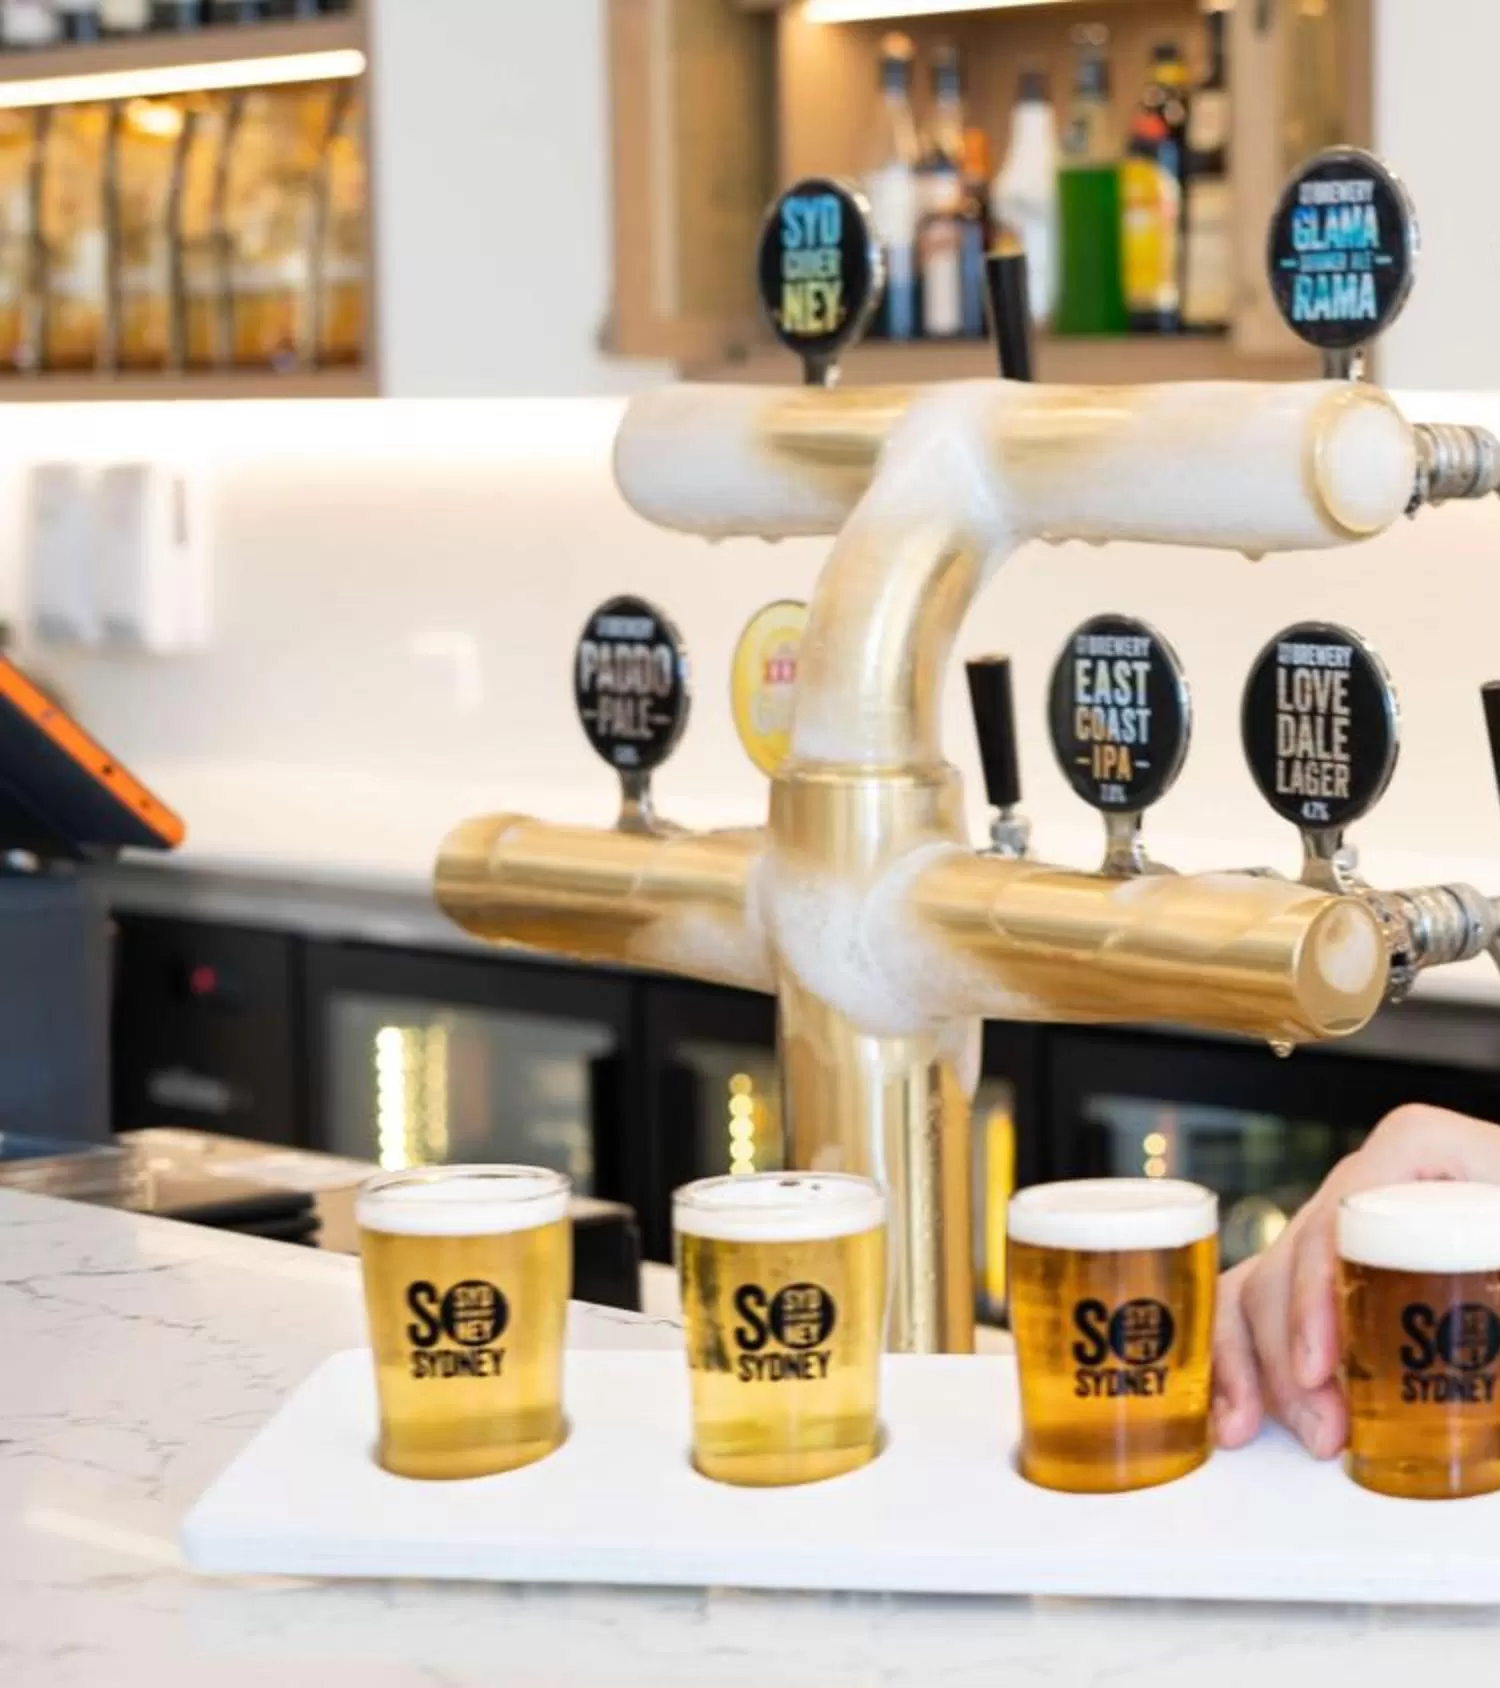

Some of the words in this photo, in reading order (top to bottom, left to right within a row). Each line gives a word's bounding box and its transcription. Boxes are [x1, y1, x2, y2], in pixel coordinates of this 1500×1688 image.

[782, 193, 842, 249] SYD
[1292, 204, 1380, 251] GLAMA
[781, 279, 842, 333] NEY
[1292, 272, 1378, 321] RAMA
[580, 640, 674, 698] PADDO
[1074, 658, 1152, 706] EAST
[1276, 666, 1351, 716] LOVE
[597, 696, 654, 739] PALE
[1074, 705, 1152, 745] COAST
[1276, 713, 1351, 763] DALE
[1092, 744, 1133, 782] IPA
[1275, 758, 1351, 800] LAGER
[411, 1347, 506, 1378] SYDNEY
[738, 1350, 832, 1382] SYDNEY
[1074, 1367, 1169, 1397] SYDNEY
[1402, 1371, 1497, 1403] SYDNEY
